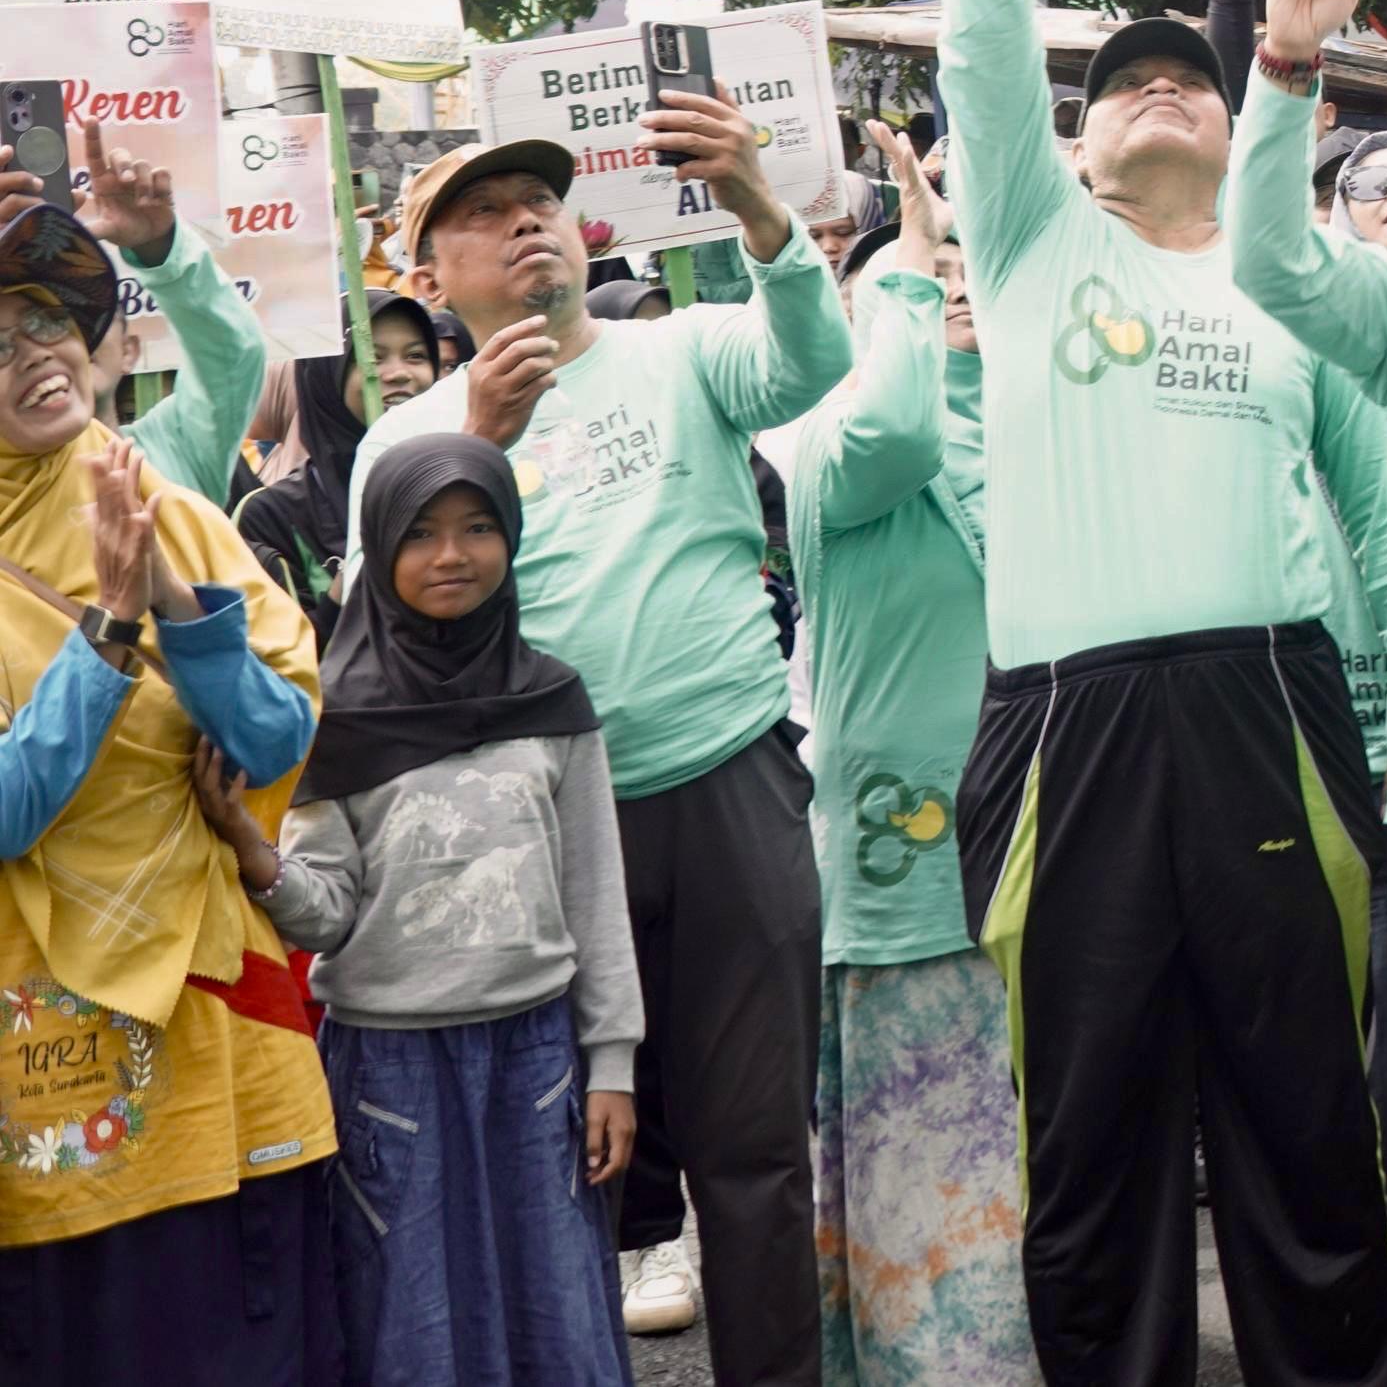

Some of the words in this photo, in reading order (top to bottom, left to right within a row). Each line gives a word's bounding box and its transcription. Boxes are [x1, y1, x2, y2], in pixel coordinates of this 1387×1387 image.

[61, 78, 187, 127] Keren
[1161, 309, 1233, 335] Hari
[1157, 335, 1251, 365] Amal
[1155, 362, 1249, 394] Bakti
[586, 404, 629, 440] ari
[594, 419, 658, 457] mal
[575, 441, 662, 498] akti
[17, 1082, 45, 1100] Kota
[48, 1069, 107, 1094] Surakarta
